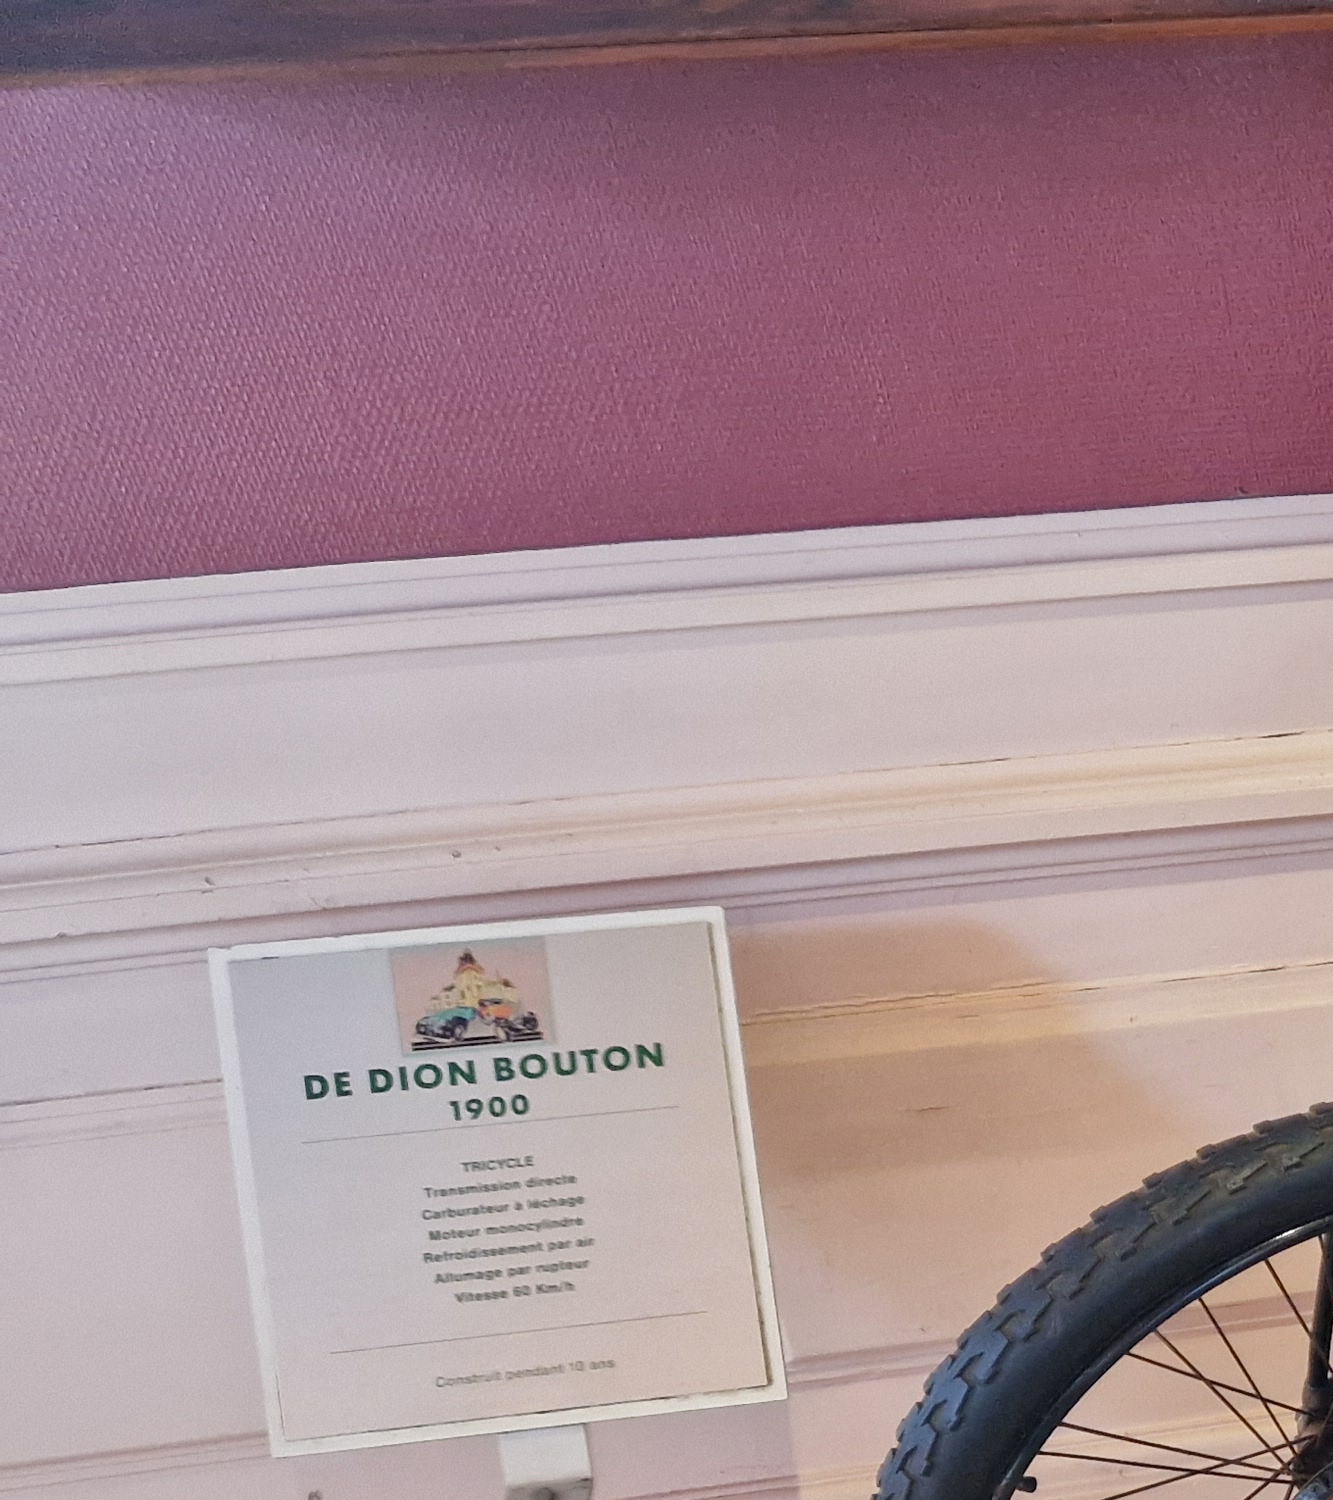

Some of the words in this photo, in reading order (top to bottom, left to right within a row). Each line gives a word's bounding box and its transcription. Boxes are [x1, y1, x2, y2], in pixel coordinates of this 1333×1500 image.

[303, 1071, 353, 1101] DE
[368, 1060, 477, 1094] DION
[492, 1042, 665, 1082] BOUTON
[449, 1093, 530, 1122] 1900
[460, 1155, 535, 1173] TRICYCLE
[423, 1180, 521, 1199] Transmission
[525, 1175, 578, 1189] directe
[421, 1203, 509, 1221] Carburateur
[428, 1227, 481, 1241] Moteur
[485, 1217, 585, 1236] monocylindre
[423, 1241, 543, 1264] Refroidissement
[547, 1240, 571, 1252] par
[575, 1237, 595, 1248] air
[434, 1268, 503, 1284] Allumage
[507, 1265, 532, 1278] par
[535, 1259, 590, 1274] rupteur
[454, 1290, 508, 1304] Vitesse
[435, 1370, 502, 1388] Construit
[505, 1364, 564, 1381] pendant
[589, 1359, 615, 1371] ans
